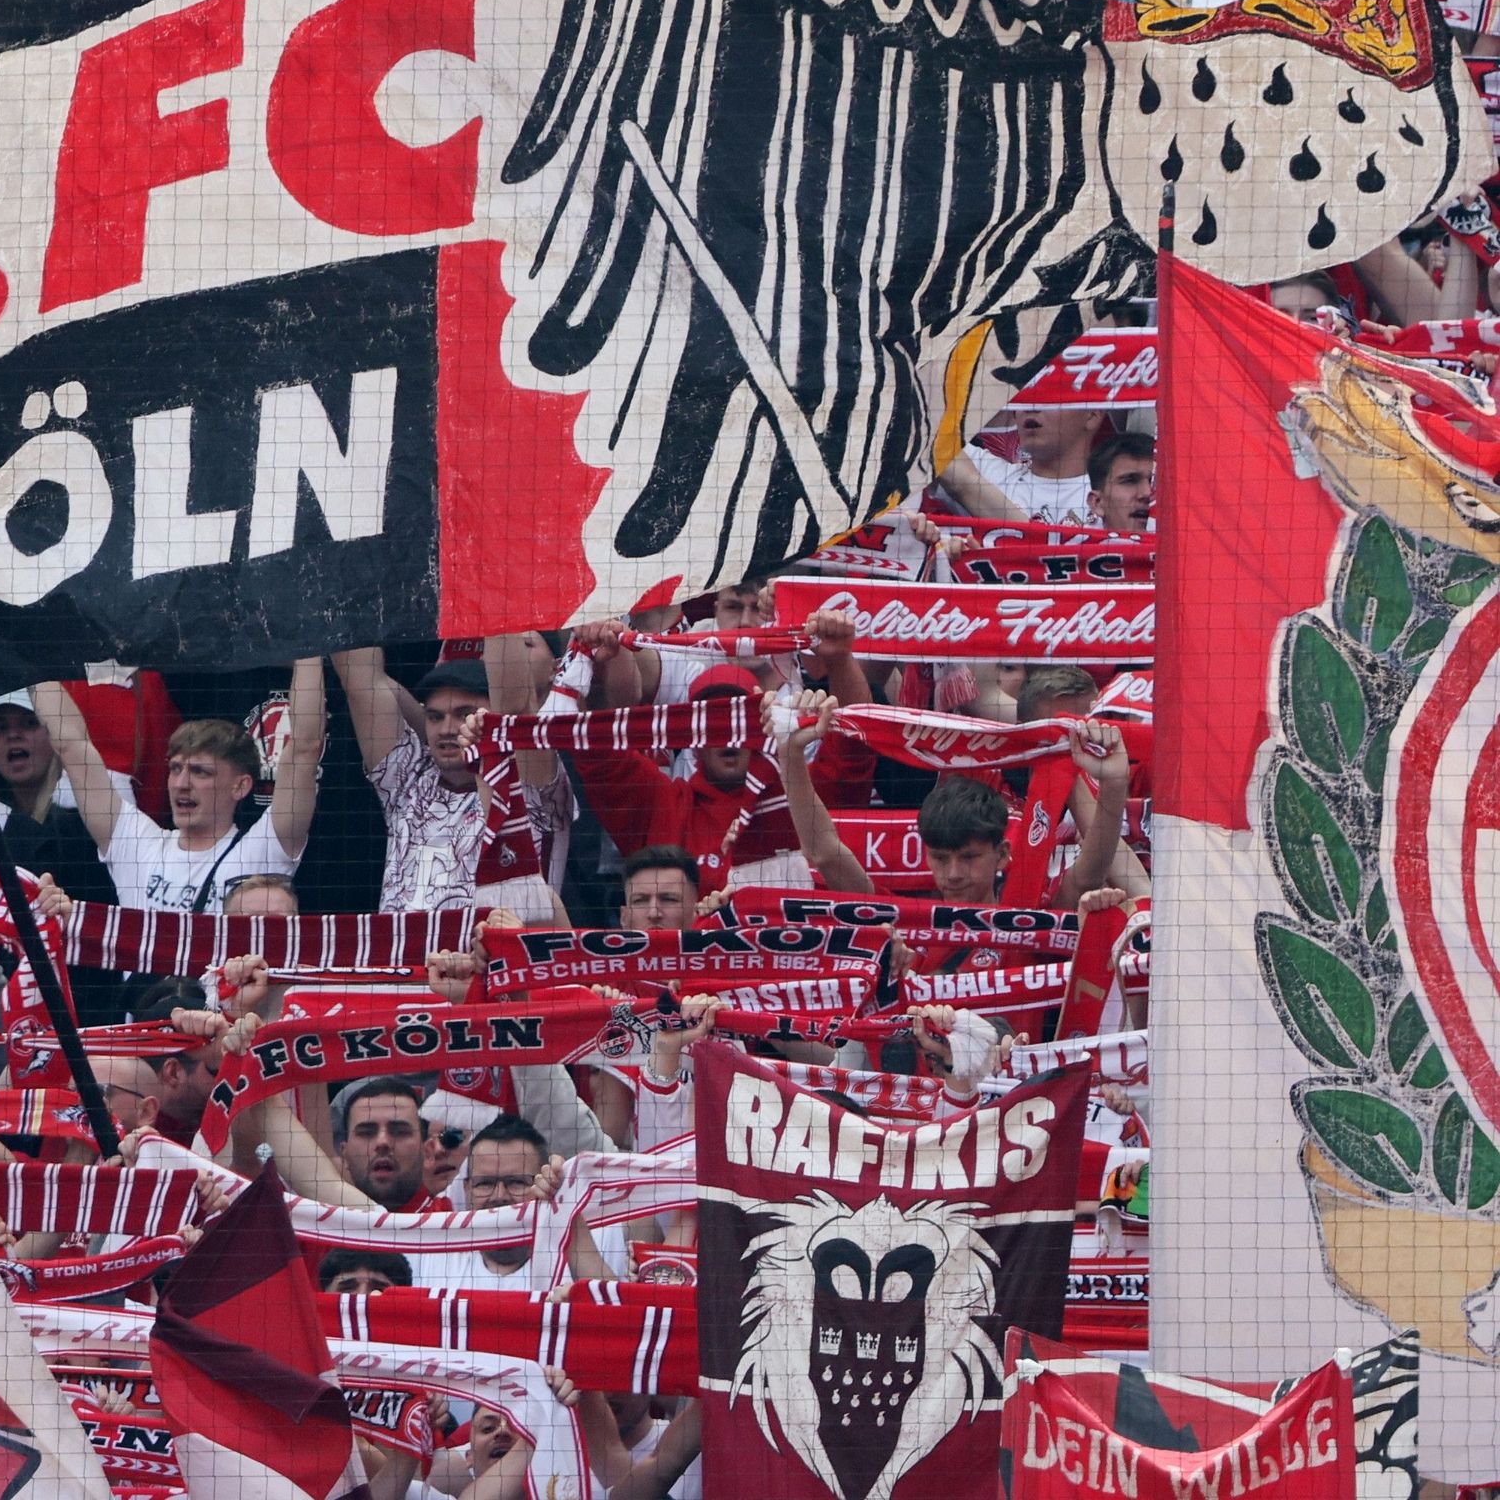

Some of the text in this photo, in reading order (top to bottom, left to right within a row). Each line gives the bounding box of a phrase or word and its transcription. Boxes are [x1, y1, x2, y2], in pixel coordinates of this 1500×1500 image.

[1040, 553, 1126, 582] FC
[780, 897, 899, 926] FC
[521, 928, 650, 965] FC
[486, 956, 627, 989] EUTSCHER
[638, 954, 765, 973] MEISTER
[832, 956, 878, 975] 1964
[718, 978, 845, 1012] ERSTER
[211, 1011, 545, 1109] 1. FC KÖLN
[725, 1073, 1057, 1191] RAFIKIS
[43, 1261, 98, 1279] STONN
[1023, 1398, 1339, 1500] DEIN WILLE
